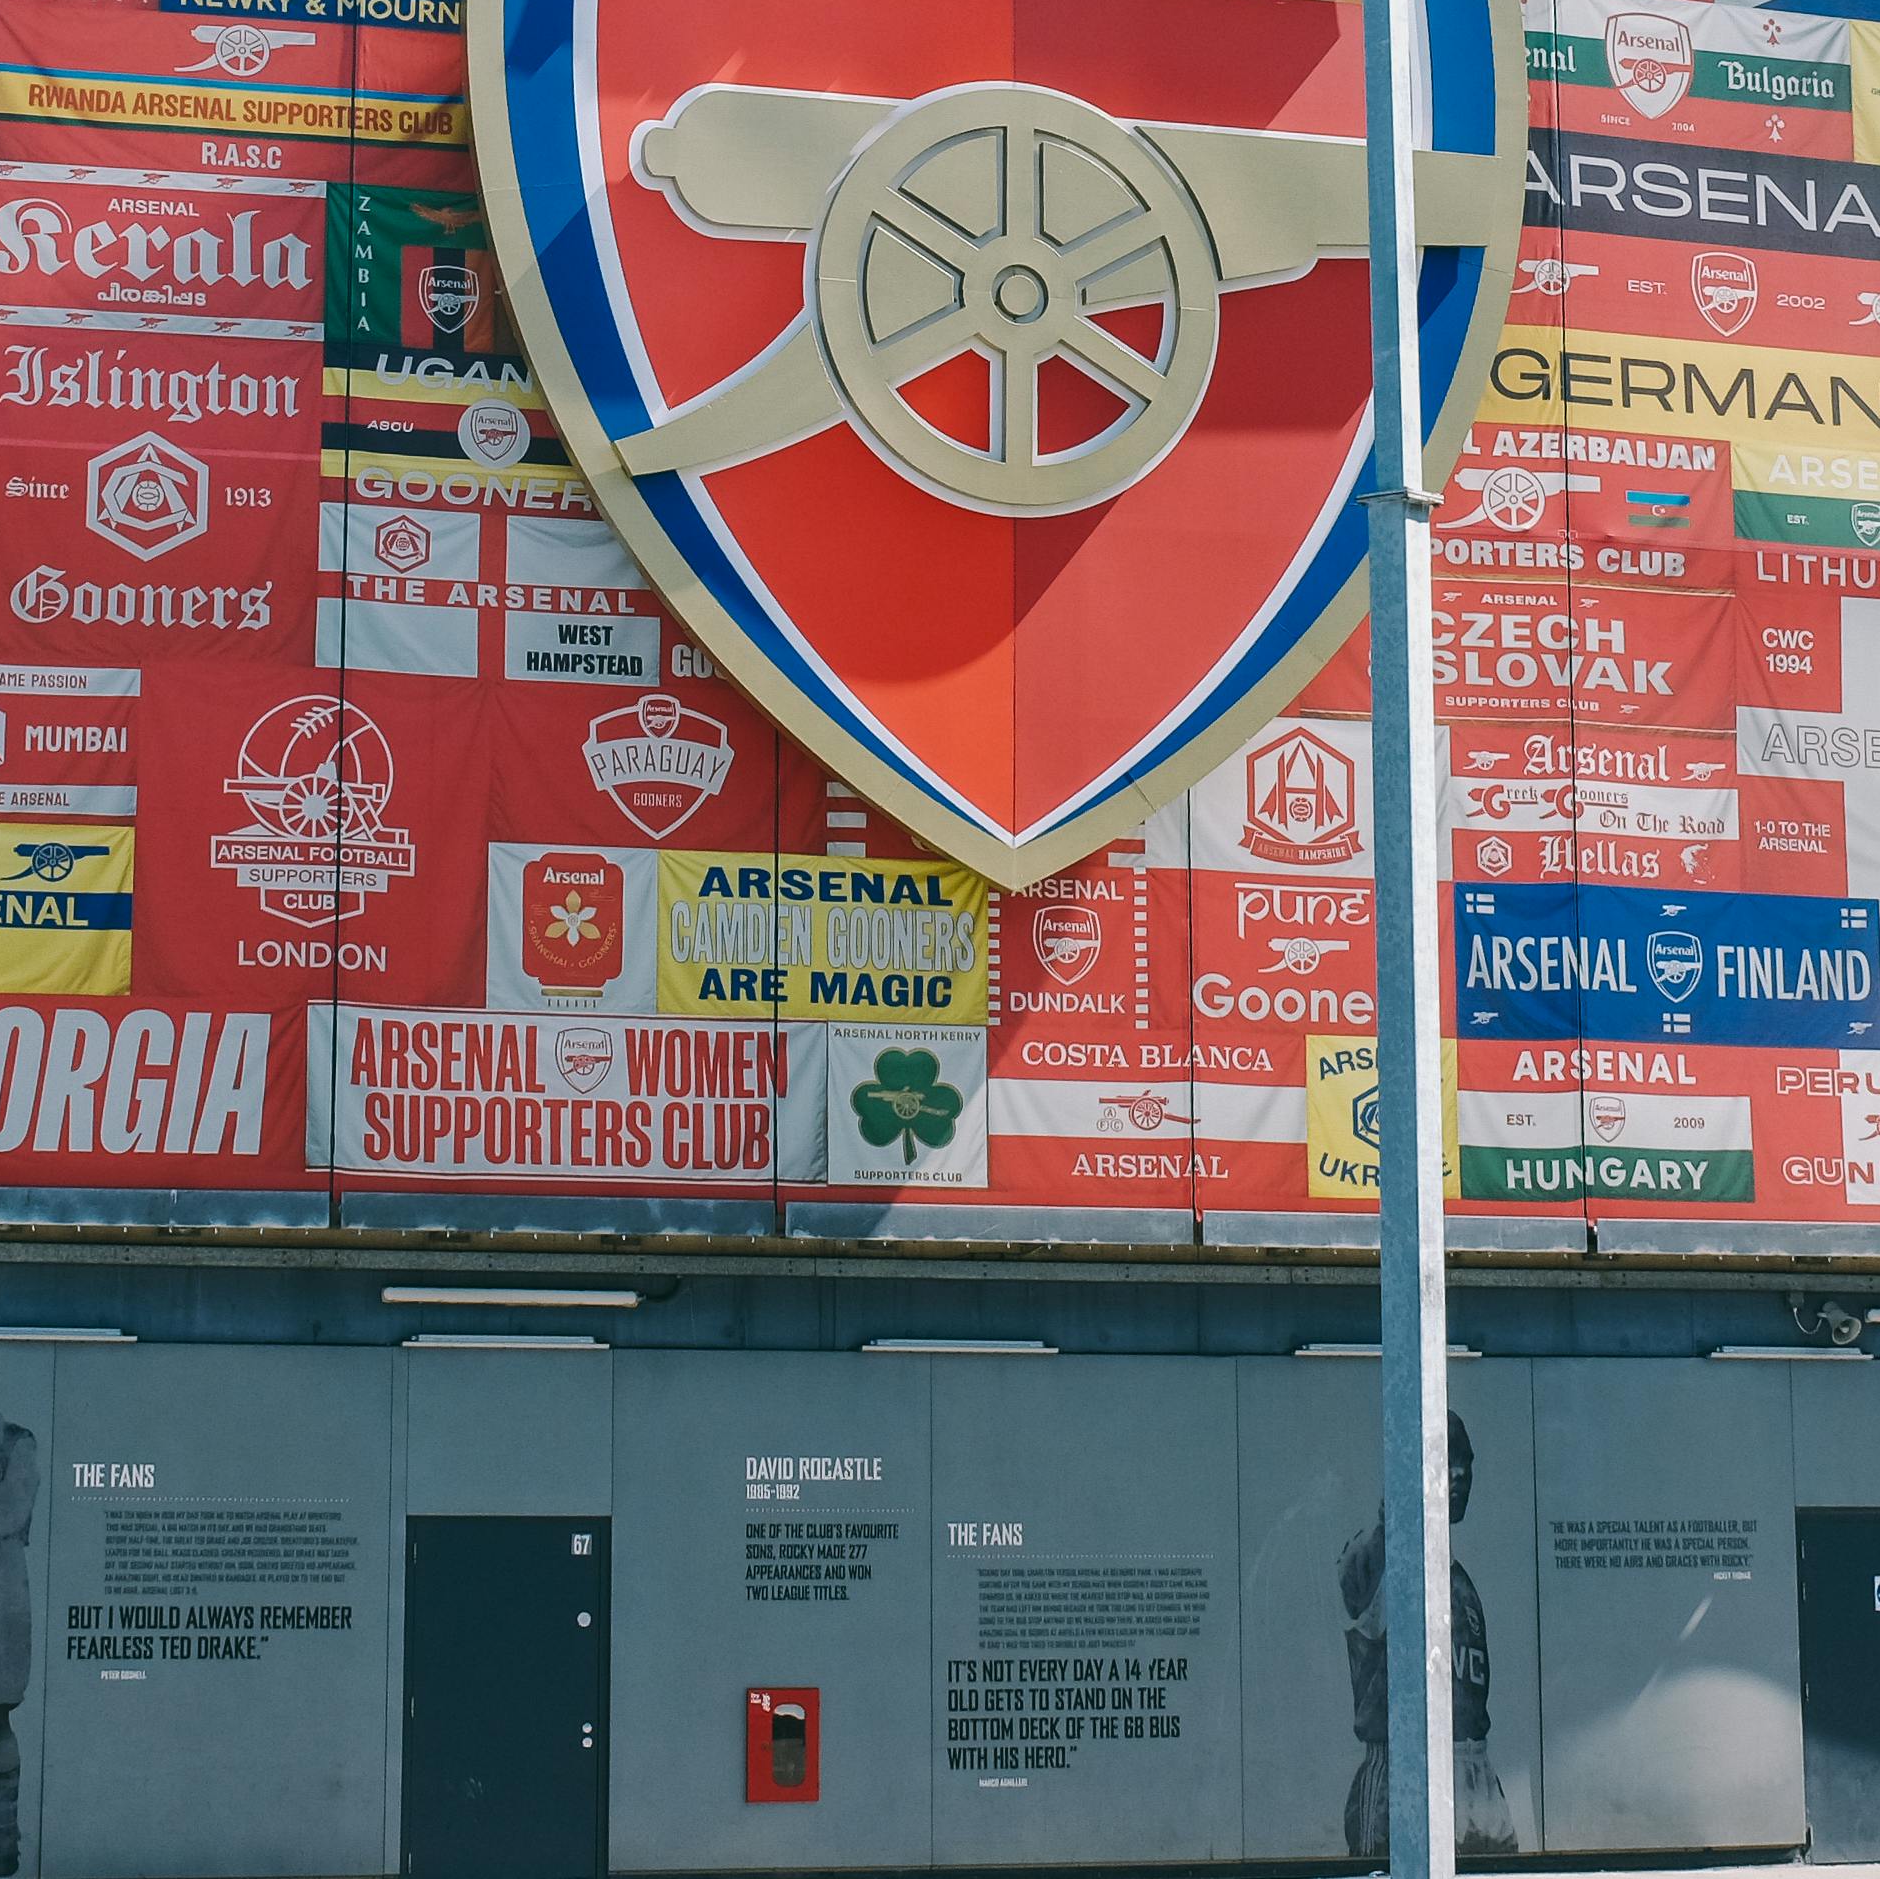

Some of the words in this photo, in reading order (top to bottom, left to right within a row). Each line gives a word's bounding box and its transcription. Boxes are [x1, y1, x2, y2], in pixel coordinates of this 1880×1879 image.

[1717, 60, 1834, 100] Bulgaria
[108, 197, 199, 217] ARSENAL
[5, 476, 69, 500] Since
[224, 487, 272, 508] 1913
[10, 565, 273, 631] Gooners
[237, 939, 387, 972] LONDON
[1467, 934, 1637, 994] ARSENAL
[1718, 943, 1871, 1002] FINLAND
[350, 1018, 547, 1095] ARSENAL
[625, 1027, 788, 1100] WOMEN
[1512, 1050, 1696, 1085] ARSENAL
[363, 1095, 652, 1167] SUPPORTERS
[662, 1106, 770, 1171] CLUB
[1506, 1156, 1709, 1192] HUNGARY
[72, 1464, 106, 1489] THE
[113, 1463, 156, 1489] FANS
[745, 1457, 794, 1481] DAVID
[798, 1457, 882, 1481] ROCASTLE
[573, 1534, 591, 1555] 67
[66, 1635, 154, 1660] FEARLESS
[161, 1635, 192, 1660] TED
